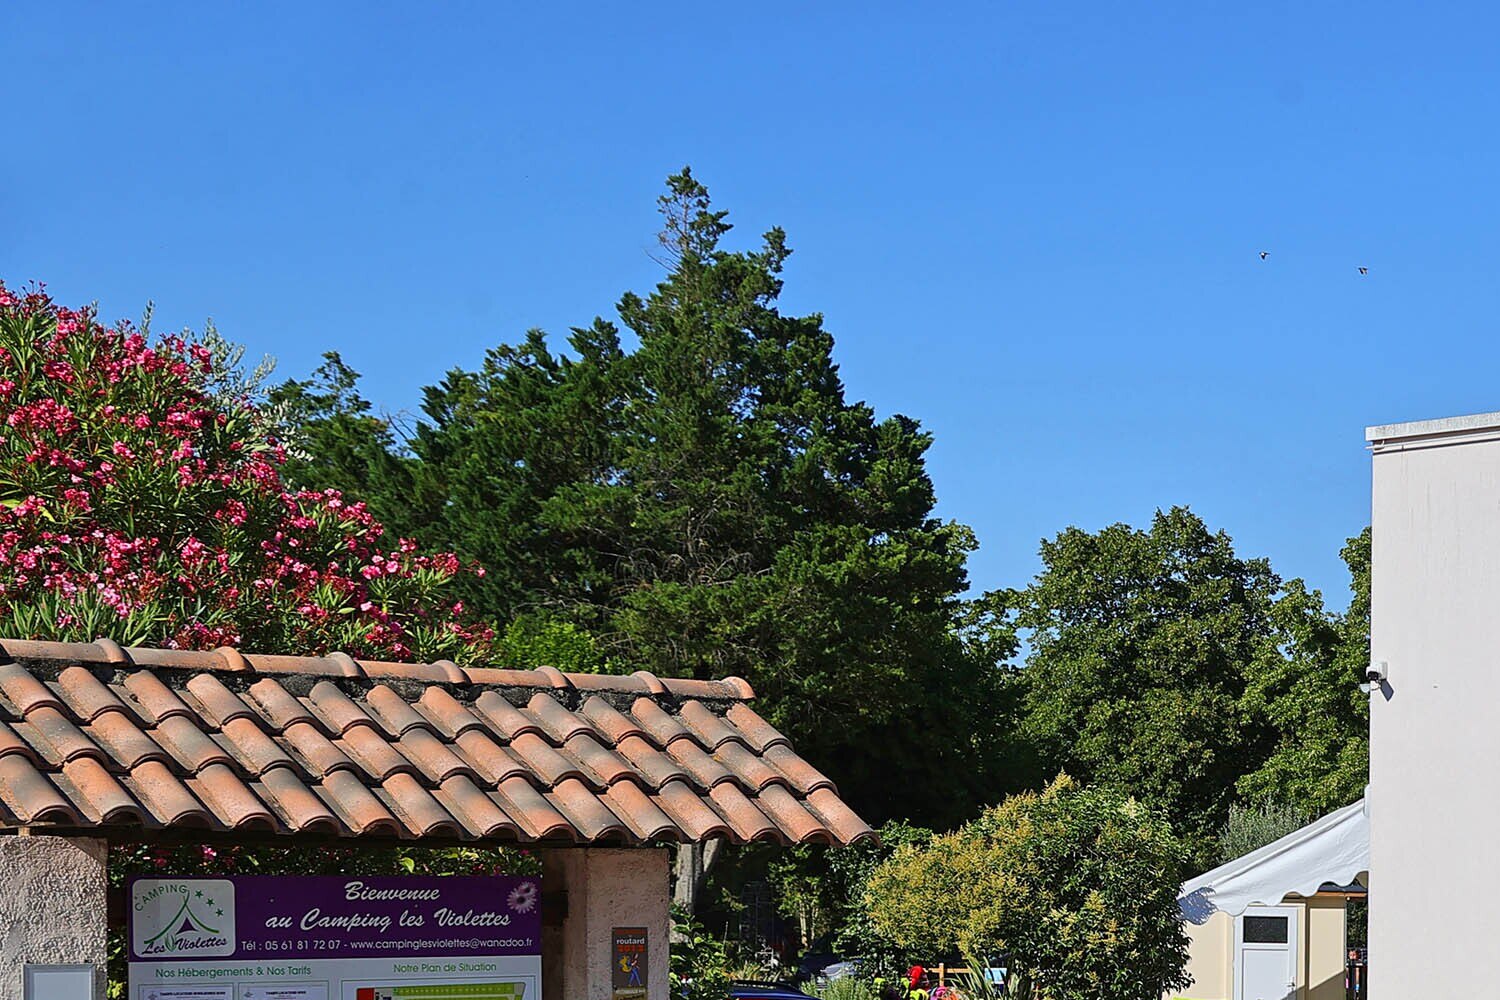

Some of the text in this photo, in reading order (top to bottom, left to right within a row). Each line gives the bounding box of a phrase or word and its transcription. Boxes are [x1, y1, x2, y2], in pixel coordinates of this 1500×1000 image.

[134, 884, 188, 912] CAMPING
[344, 881, 440, 901] Bienvenue
[265, 908, 511, 932] au Camping les Violettes
[141, 936, 228, 954] Les Violettes
[241, 940, 257, 951] Tél
[265, 940, 278, 950] 05
[281, 940, 293, 950] 61
[297, 940, 309, 950] 81
[314, 940, 327, 949] 72
[328, 940, 340, 950] 07
[350, 937, 533, 951] www.campinglesviolettes@wanadoo.fr
[616, 937, 645, 945] routard
[155, 969, 175, 978] Nos
[178, 966, 252, 979] Hébergements
[266, 967, 286, 976] Nos
[287, 966, 312, 976] Tarifs
[394, 962, 497, 973] Notre Plan de Situation
